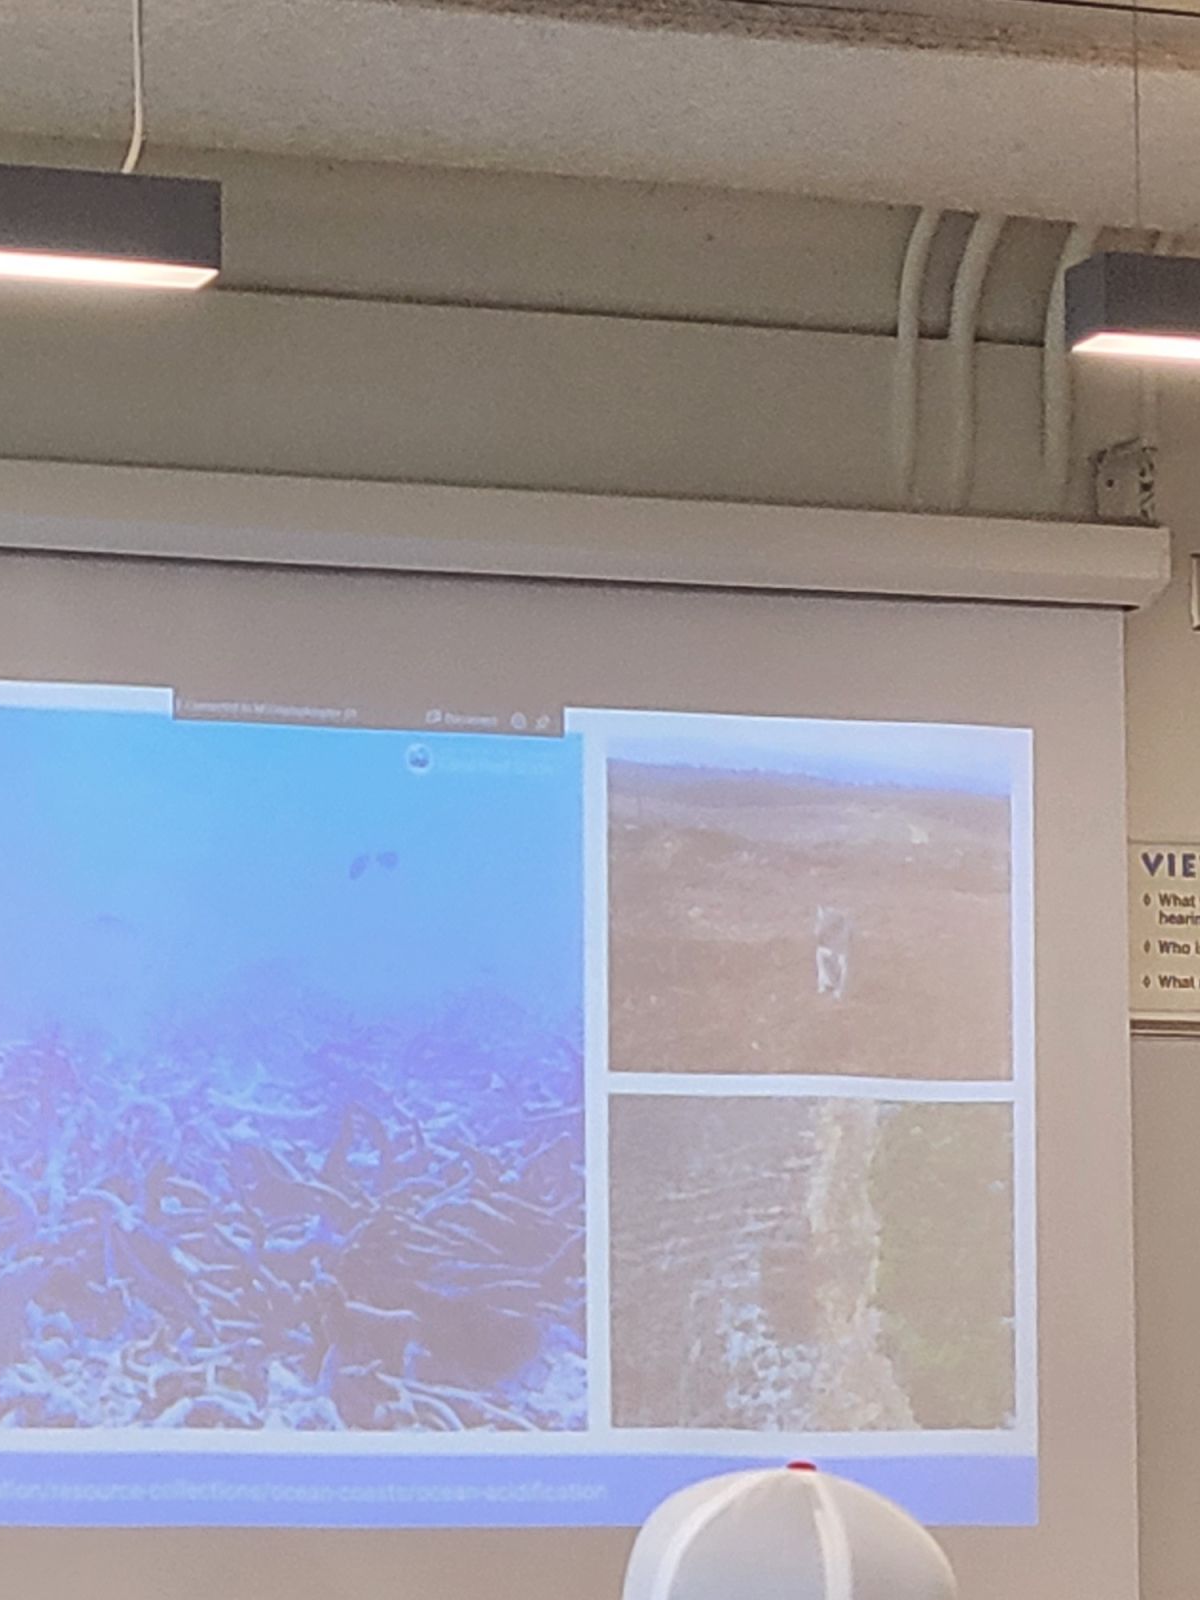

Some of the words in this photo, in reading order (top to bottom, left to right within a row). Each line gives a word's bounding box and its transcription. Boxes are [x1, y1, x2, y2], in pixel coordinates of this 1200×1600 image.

[1141, 852, 1200, 878] VIE
[1158, 892, 1196, 908] What
[1158, 939, 1191, 955] Who
[1158, 974, 1195, 989] What
